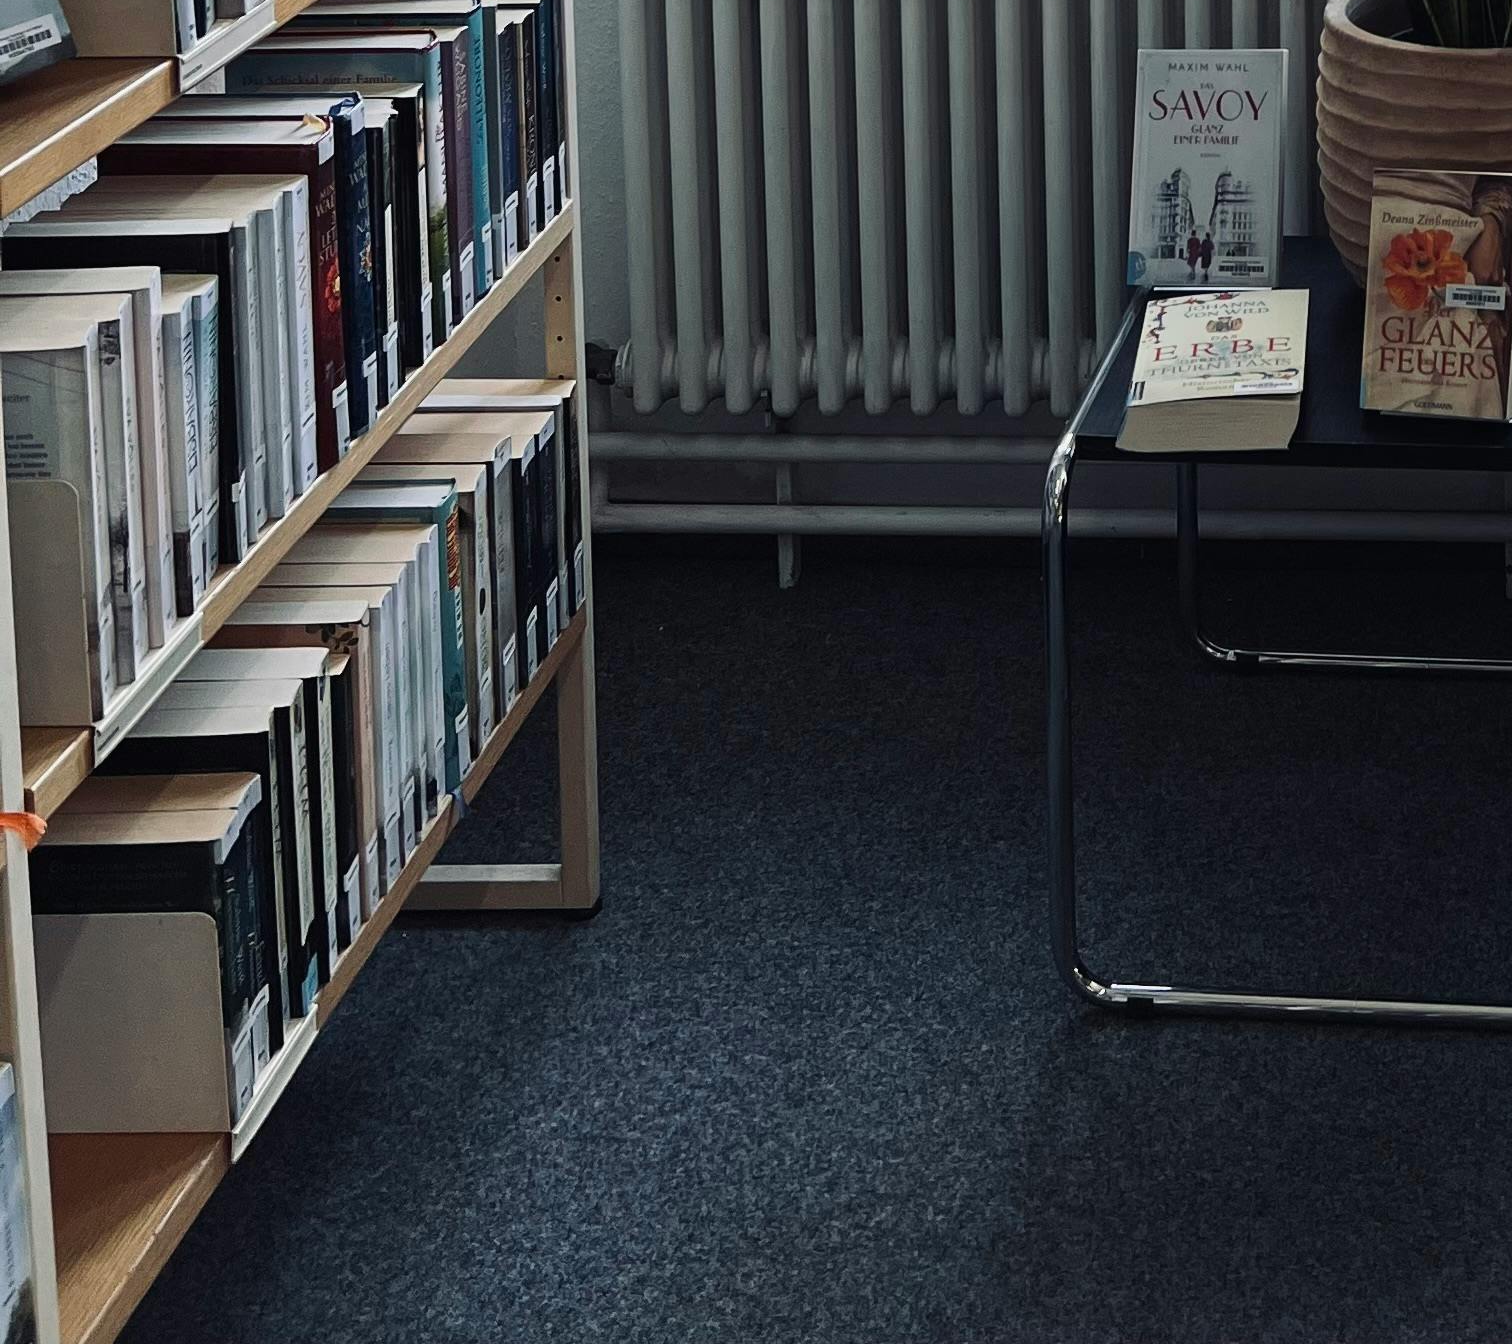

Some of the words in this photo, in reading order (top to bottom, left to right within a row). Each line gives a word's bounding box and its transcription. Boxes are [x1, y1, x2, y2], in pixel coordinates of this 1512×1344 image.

[1168, 63, 1210, 72] MAXIM
[1216, 63, 1250, 72] WAHL
[1148, 89, 1268, 122] SAVOY
[1191, 124, 1224, 134] GLANZ
[1173, 135, 1200, 146] EINER
[1204, 135, 1240, 146] FAMILIE
[1381, 212, 1414, 226] Deana
[1416, 214, 1480, 228] Zinßmeister
[1188, 300, 1266, 312] JOHANNA
[1184, 310, 1220, 320] VON
[1226, 307, 1270, 318] WILD
[1381, 316, 1494, 350] GLANZ
[1152, 337, 1292, 362] ERBE
[1237, 357, 1292, 370] TAXIS
[1379, 345, 1496, 380] FEUERS
